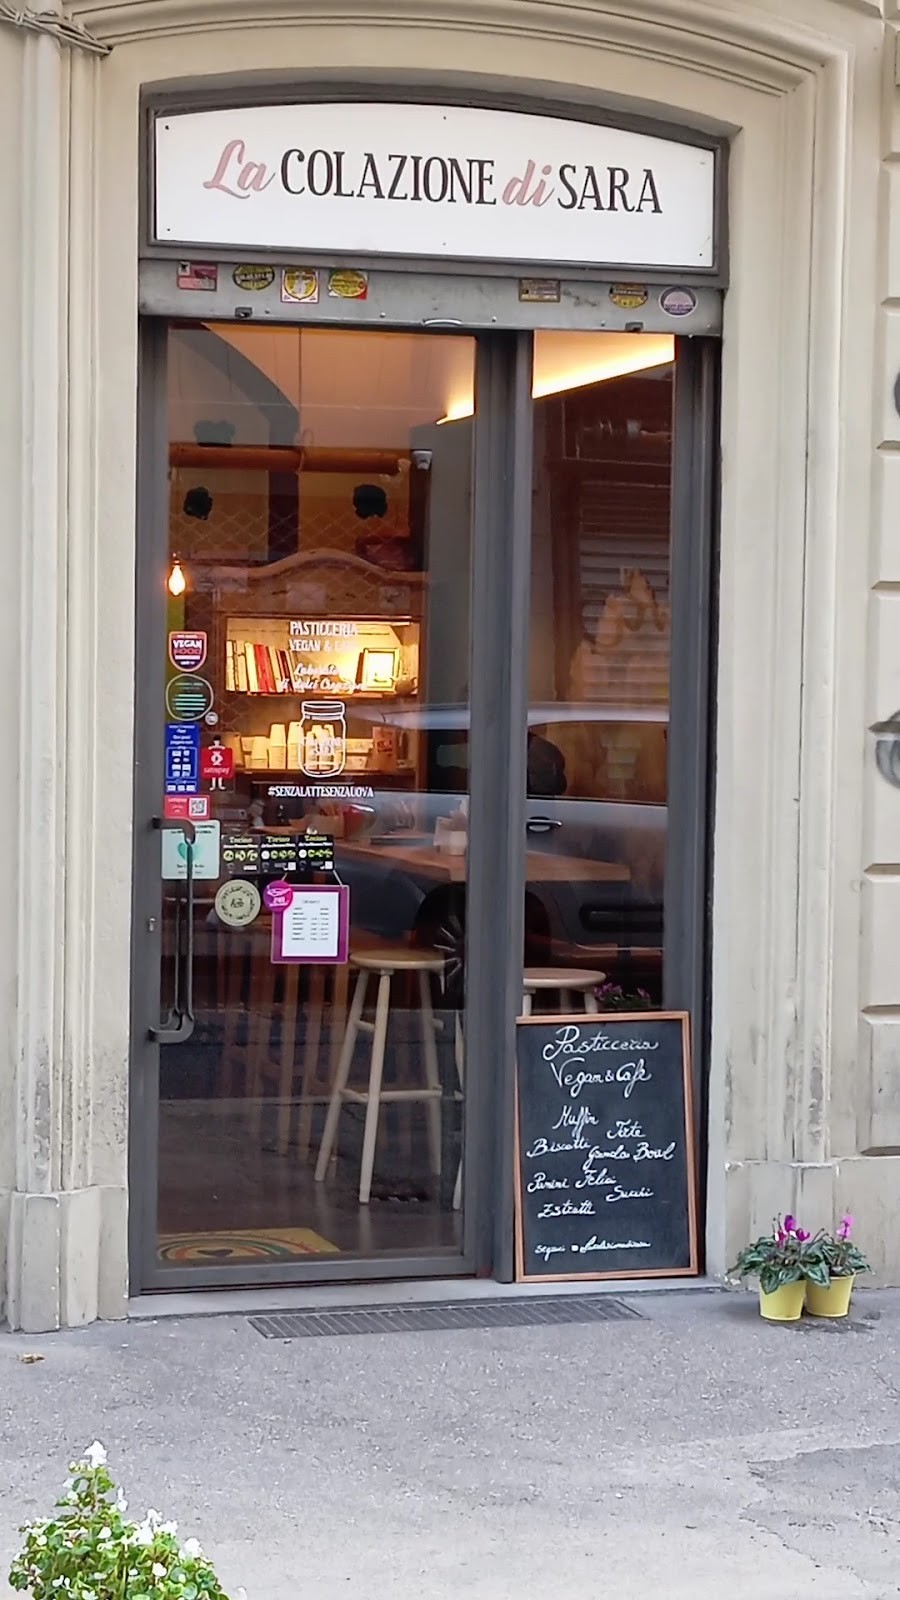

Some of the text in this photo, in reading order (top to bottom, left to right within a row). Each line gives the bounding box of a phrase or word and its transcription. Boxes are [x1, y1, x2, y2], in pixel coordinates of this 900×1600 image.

[203, 139, 663, 214] La COLAZIONE di SARA
[289, 620, 358, 637] PASTICCERIA
[173, 639, 202, 649] VEGAN
[288, 638, 321, 652] VEGAN
[267, 785, 375, 798] #SENZALATTESENZAUOVA
[266, 835, 291, 843] Torino
[542, 1025, 659, 1061] Pasticceria
[550, 1057, 604, 1098] Vegan
[604, 1069, 614, 1082] &
[552, 1105, 599, 1141] Muffin
[526, 1138, 591, 1158] Biscotti
[633, 1141, 676, 1162] Bowl
[527, 1172, 570, 1193] Panini
